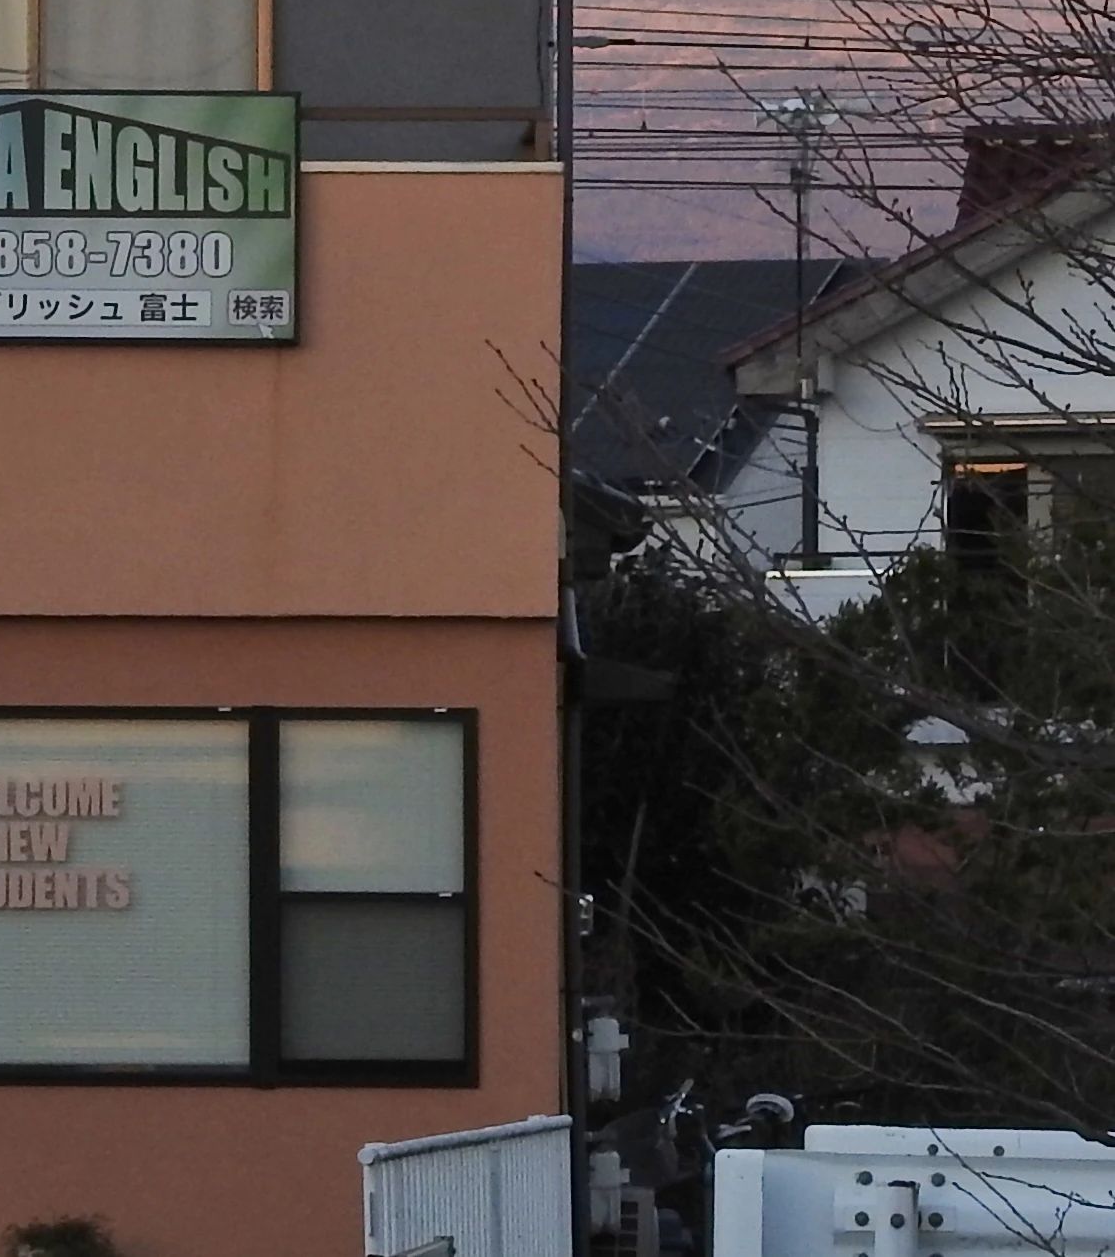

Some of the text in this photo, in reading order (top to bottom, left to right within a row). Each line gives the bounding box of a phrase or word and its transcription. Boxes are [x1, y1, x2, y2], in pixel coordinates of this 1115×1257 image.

[43, 108, 285, 213] ENGLISH
[139, 293, 199, 322] 富士
[232, 293, 284, 321] 検索
